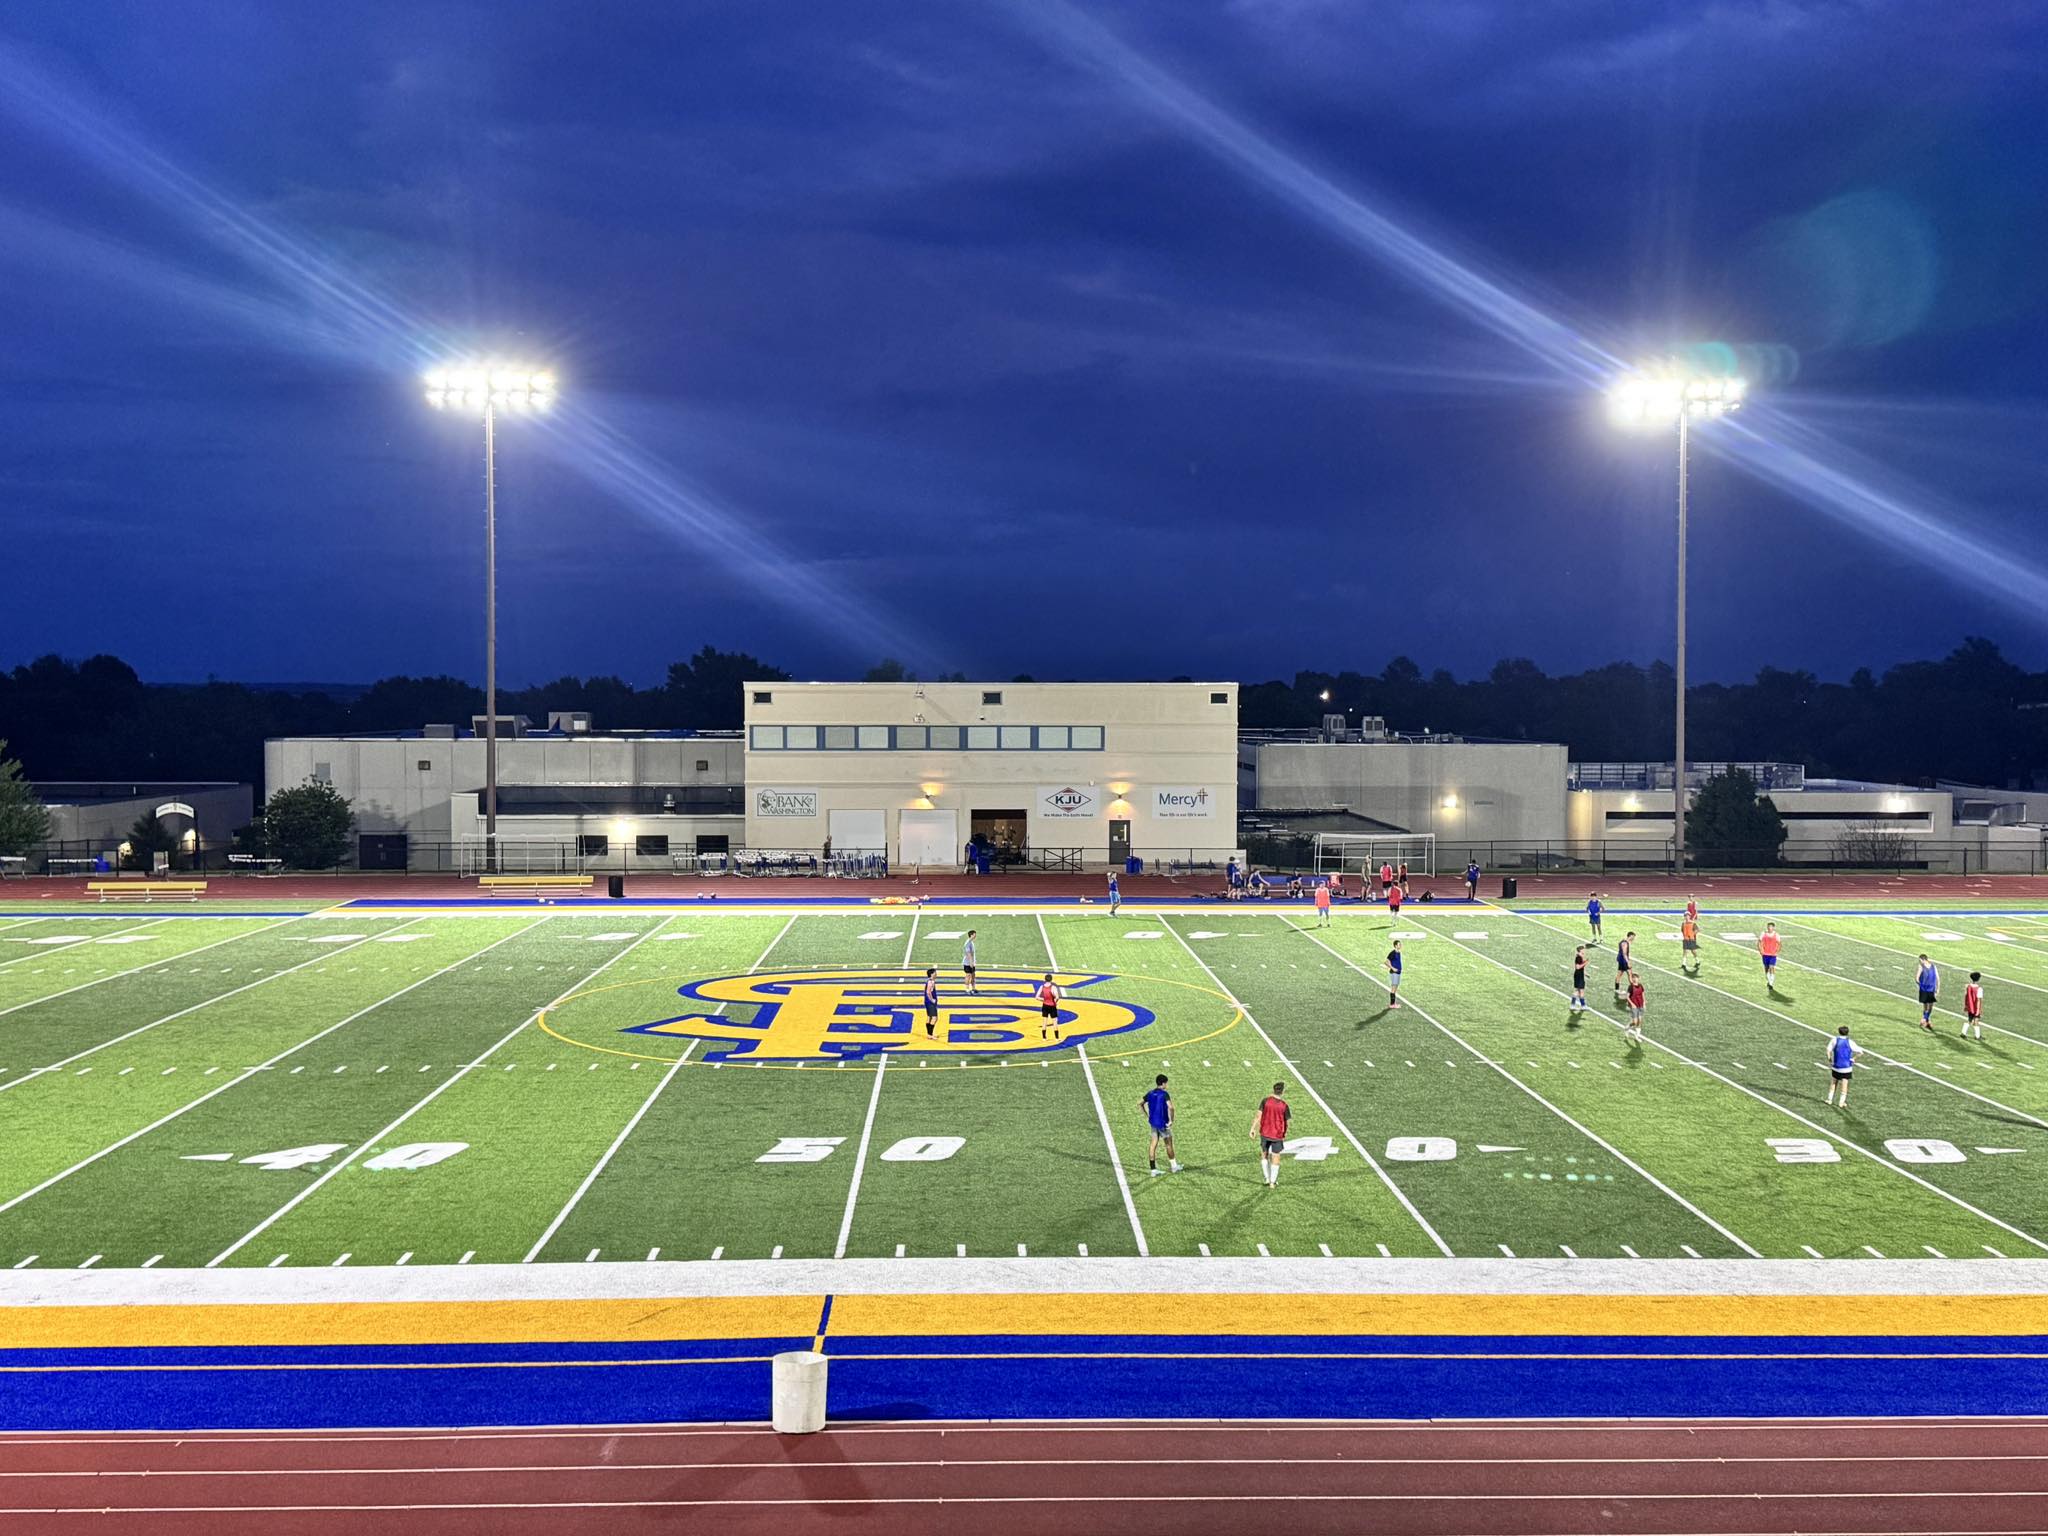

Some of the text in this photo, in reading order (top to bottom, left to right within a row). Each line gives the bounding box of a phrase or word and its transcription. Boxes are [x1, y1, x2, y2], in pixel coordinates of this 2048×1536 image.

[777, 796, 810, 807] BANK
[1055, 795, 1082, 805] KJU
[1159, 793, 1198, 808] Mercy
[755, 1136, 967, 1163] 50
[1764, 1137, 1968, 1164] 30
